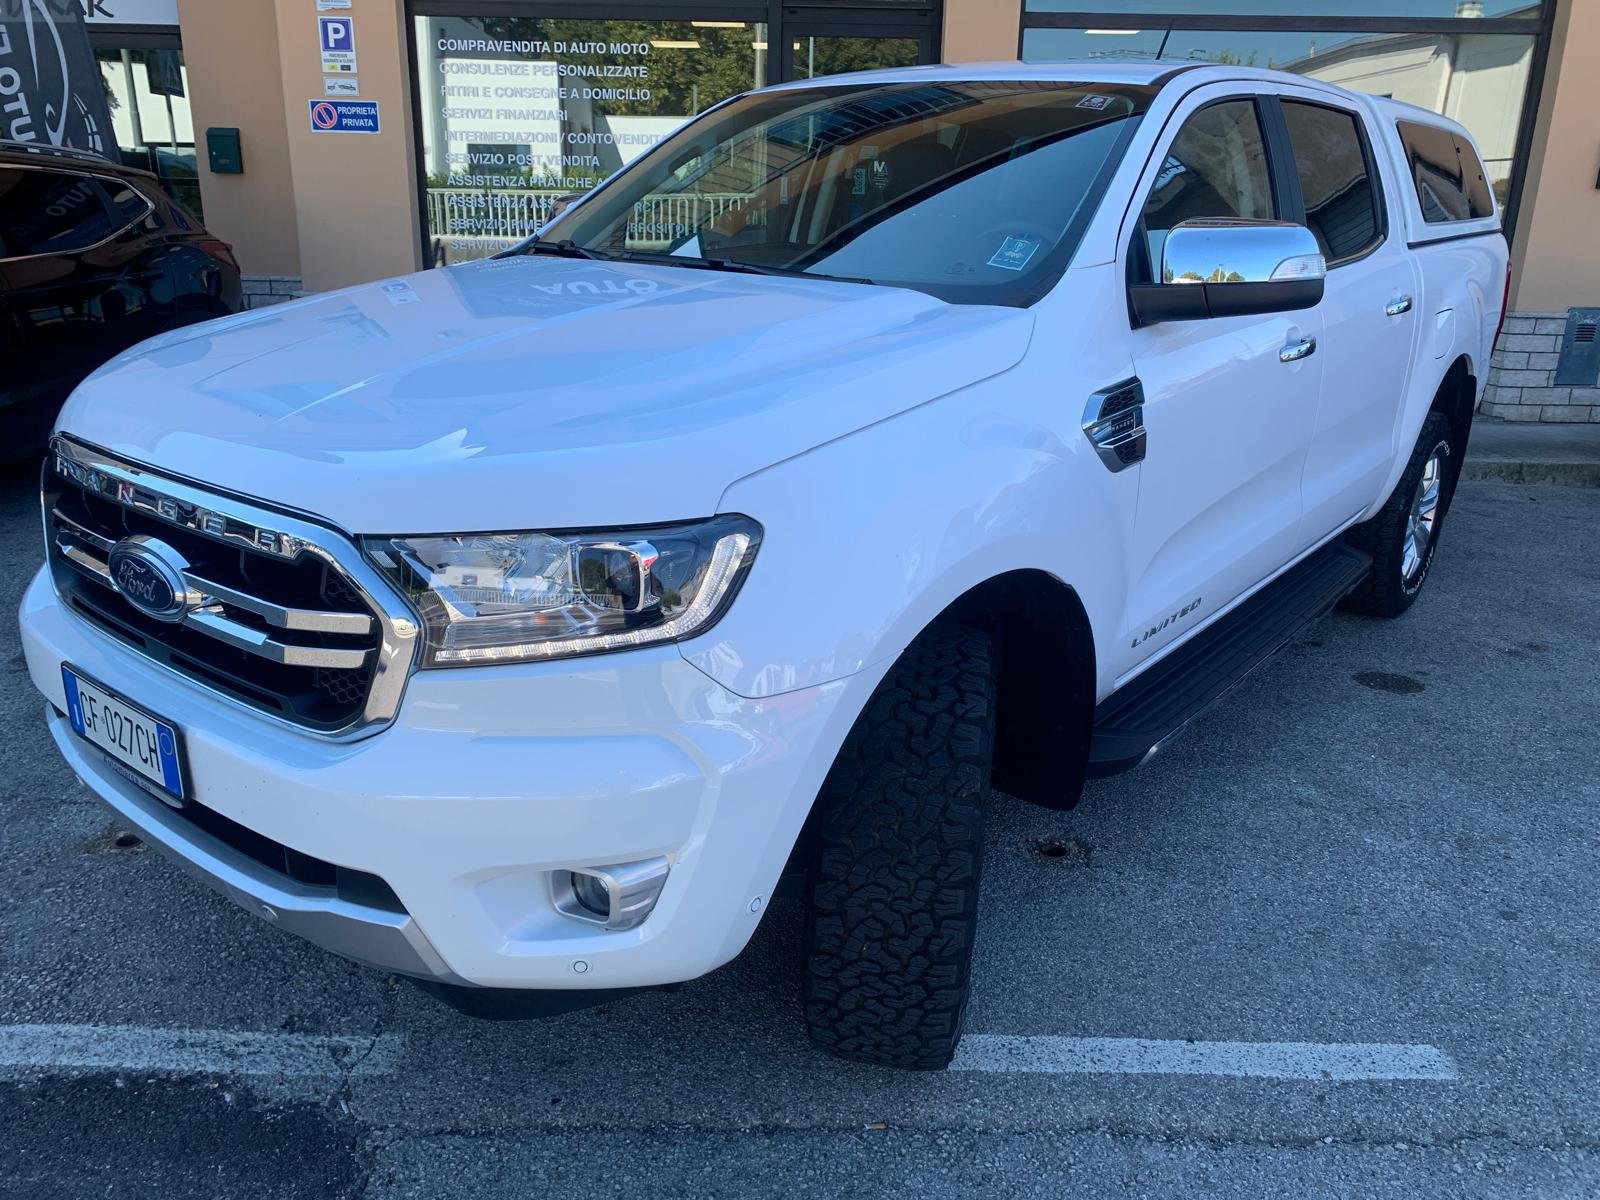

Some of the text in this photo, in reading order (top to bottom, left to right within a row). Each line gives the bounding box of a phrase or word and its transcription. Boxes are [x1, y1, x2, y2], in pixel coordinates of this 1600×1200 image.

[327, 22, 346, 48] P
[437, 38, 649, 55] COMPRAVENDITA DI AUTO MOTO
[439, 62, 648, 78] CONSULENZE PERSONALIZZATE
[441, 85, 650, 100] RITIRI E CONSEGNE A DOMICILIO
[441, 107, 568, 121] SERVIZI FINANZIARI
[342, 118, 374, 127] PRIVATA
[444, 129, 558, 143] INTERMEDIAZIONI
[567, 132, 661, 145] CONTOVENDIT
[445, 152, 600, 167] SERVIZIO POST VENDITA
[447, 174, 527, 187] ASSISTENZA
[530, 176, 593, 189] PRATICHE
[447, 196, 554, 210] ASSISTENZA ASS
[449, 217, 542, 231] SERVIZIO RIME
[451, 239, 509, 252] SERVIZIO
[118, 559, 156, 602] Ford
[1130, 597, 1202, 649] LIMITED
[103, 704, 161, 773] 027CH
